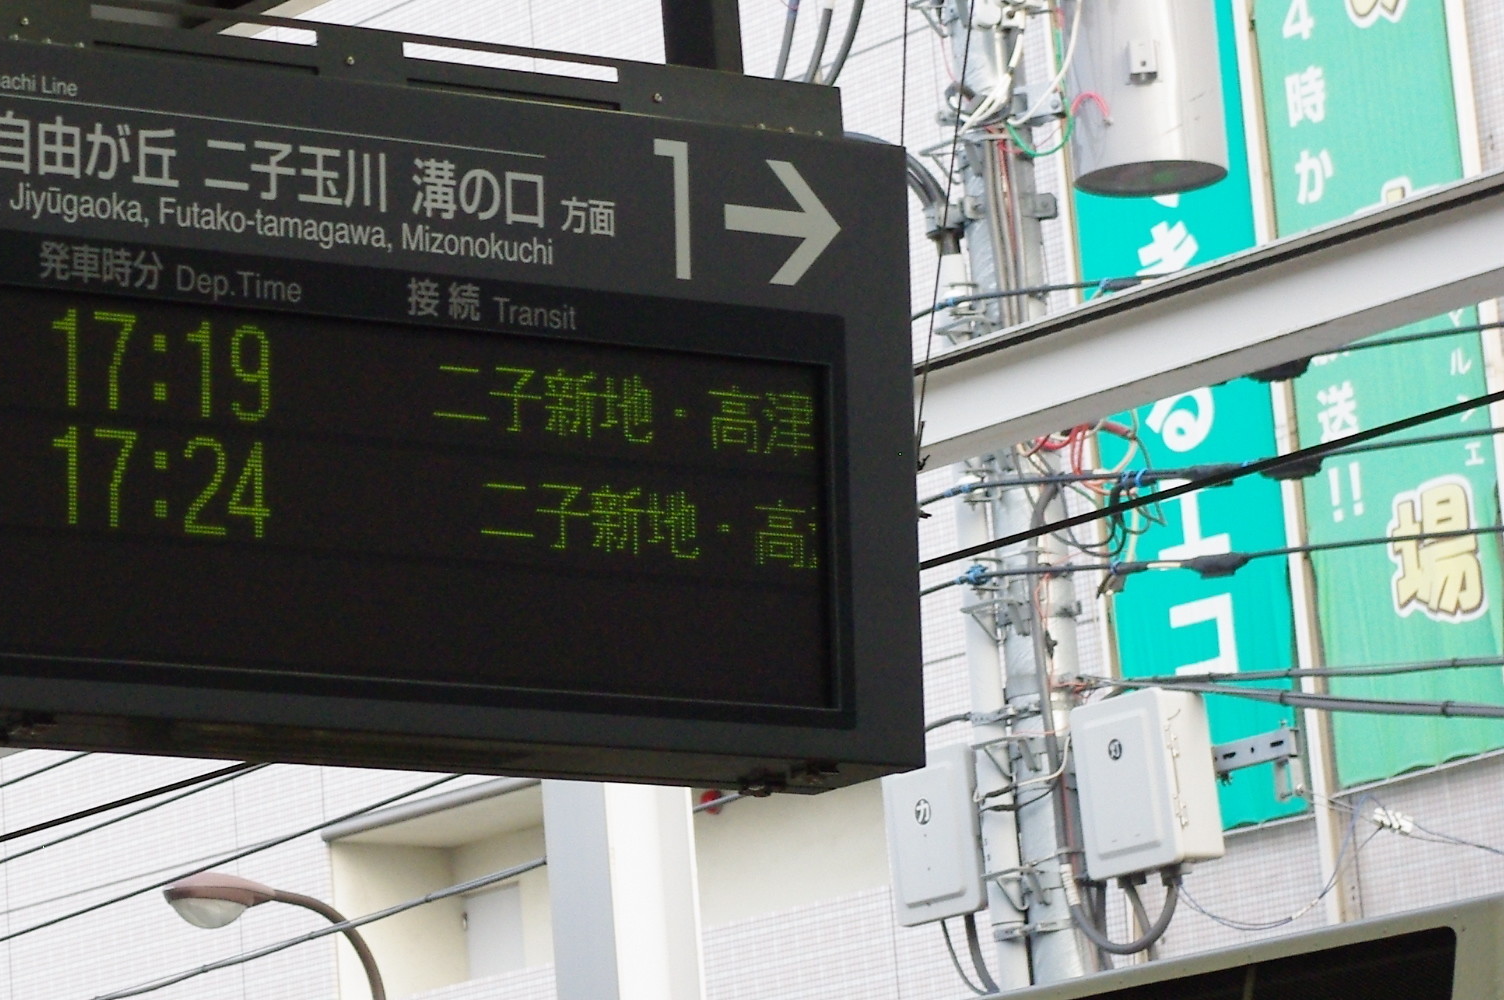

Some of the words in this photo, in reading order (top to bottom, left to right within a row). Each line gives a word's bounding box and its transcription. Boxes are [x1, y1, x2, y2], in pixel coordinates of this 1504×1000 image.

[41, 74, 78, 98] Line
[204, 137, 388, 213] 二子玉川
[411, 157, 546, 229] 溝の口
[560, 196, 616, 238] 方面
[653, 138, 693, 280] 1
[39, 240, 164, 293] 発車時分
[159, 198, 393, 252] Futako-tamagawa,
[401, 223, 554, 266] Mizonokuchi
[407, 277, 481, 322] 接続
[492, 296, 578, 331] Transit
[50, 308, 271, 423] 17:19
[52, 425, 271, 539] 17:24
